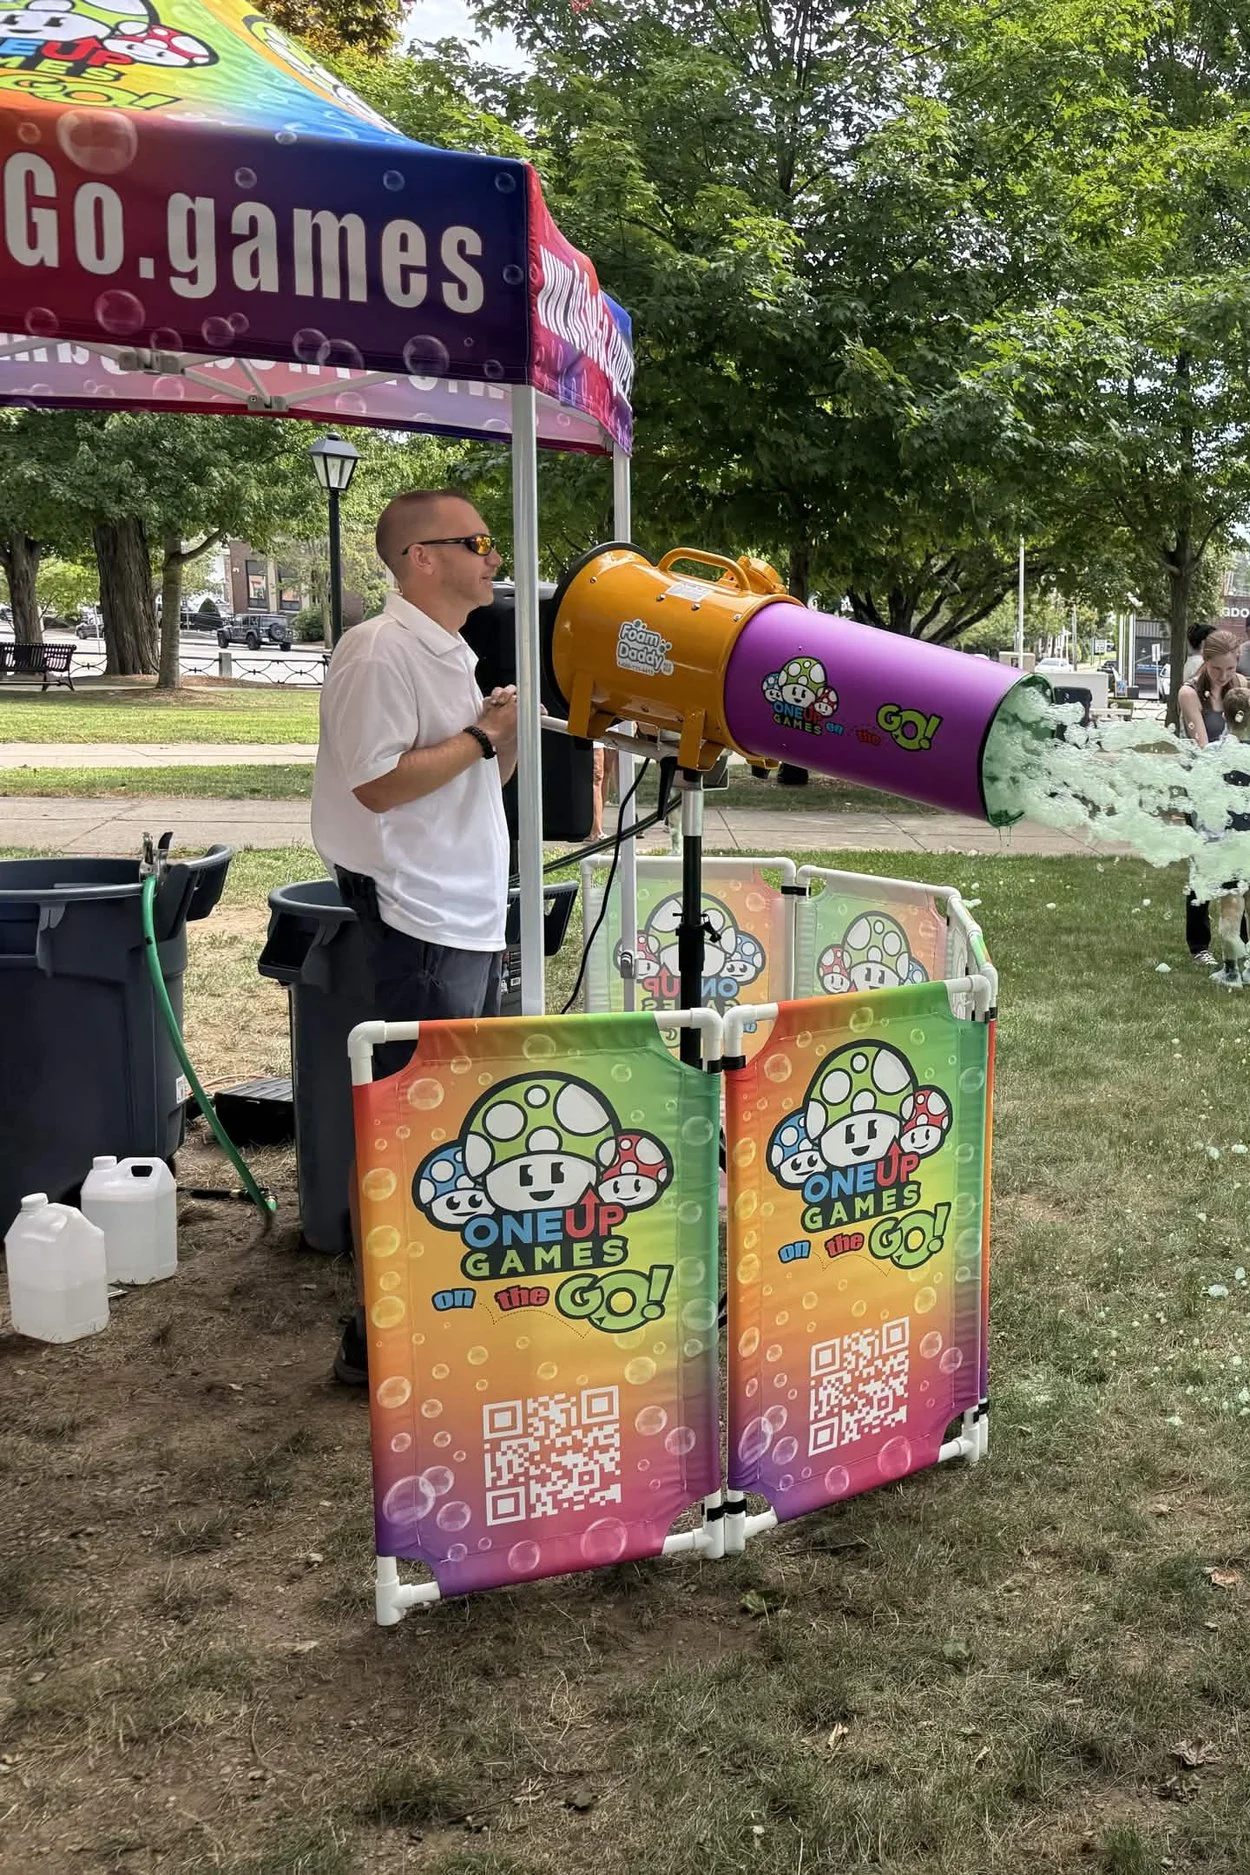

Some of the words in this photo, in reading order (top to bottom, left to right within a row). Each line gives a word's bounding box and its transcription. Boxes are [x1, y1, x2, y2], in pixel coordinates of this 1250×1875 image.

[0, 36, 134, 66] EUP
[5, 152, 485, 314] Go.games
[618, 641, 664, 671] Daddy
[620, 623, 660, 647] Foam
[773, 713, 822, 736] GAMES
[876, 702, 943, 751] GO!
[803, 1140, 920, 1203] ONEUP
[464, 1184, 625, 1249] ONEUP
[804, 1183, 920, 1230] GAMES
[465, 1239, 626, 1277] GAMES
[779, 1240, 811, 1263] on
[824, 1232, 865, 1257] the
[868, 1202, 951, 1269] GO!
[432, 1288, 476, 1311] on
[495, 1285, 549, 1311] the
[555, 1265, 674, 1333] GO!
